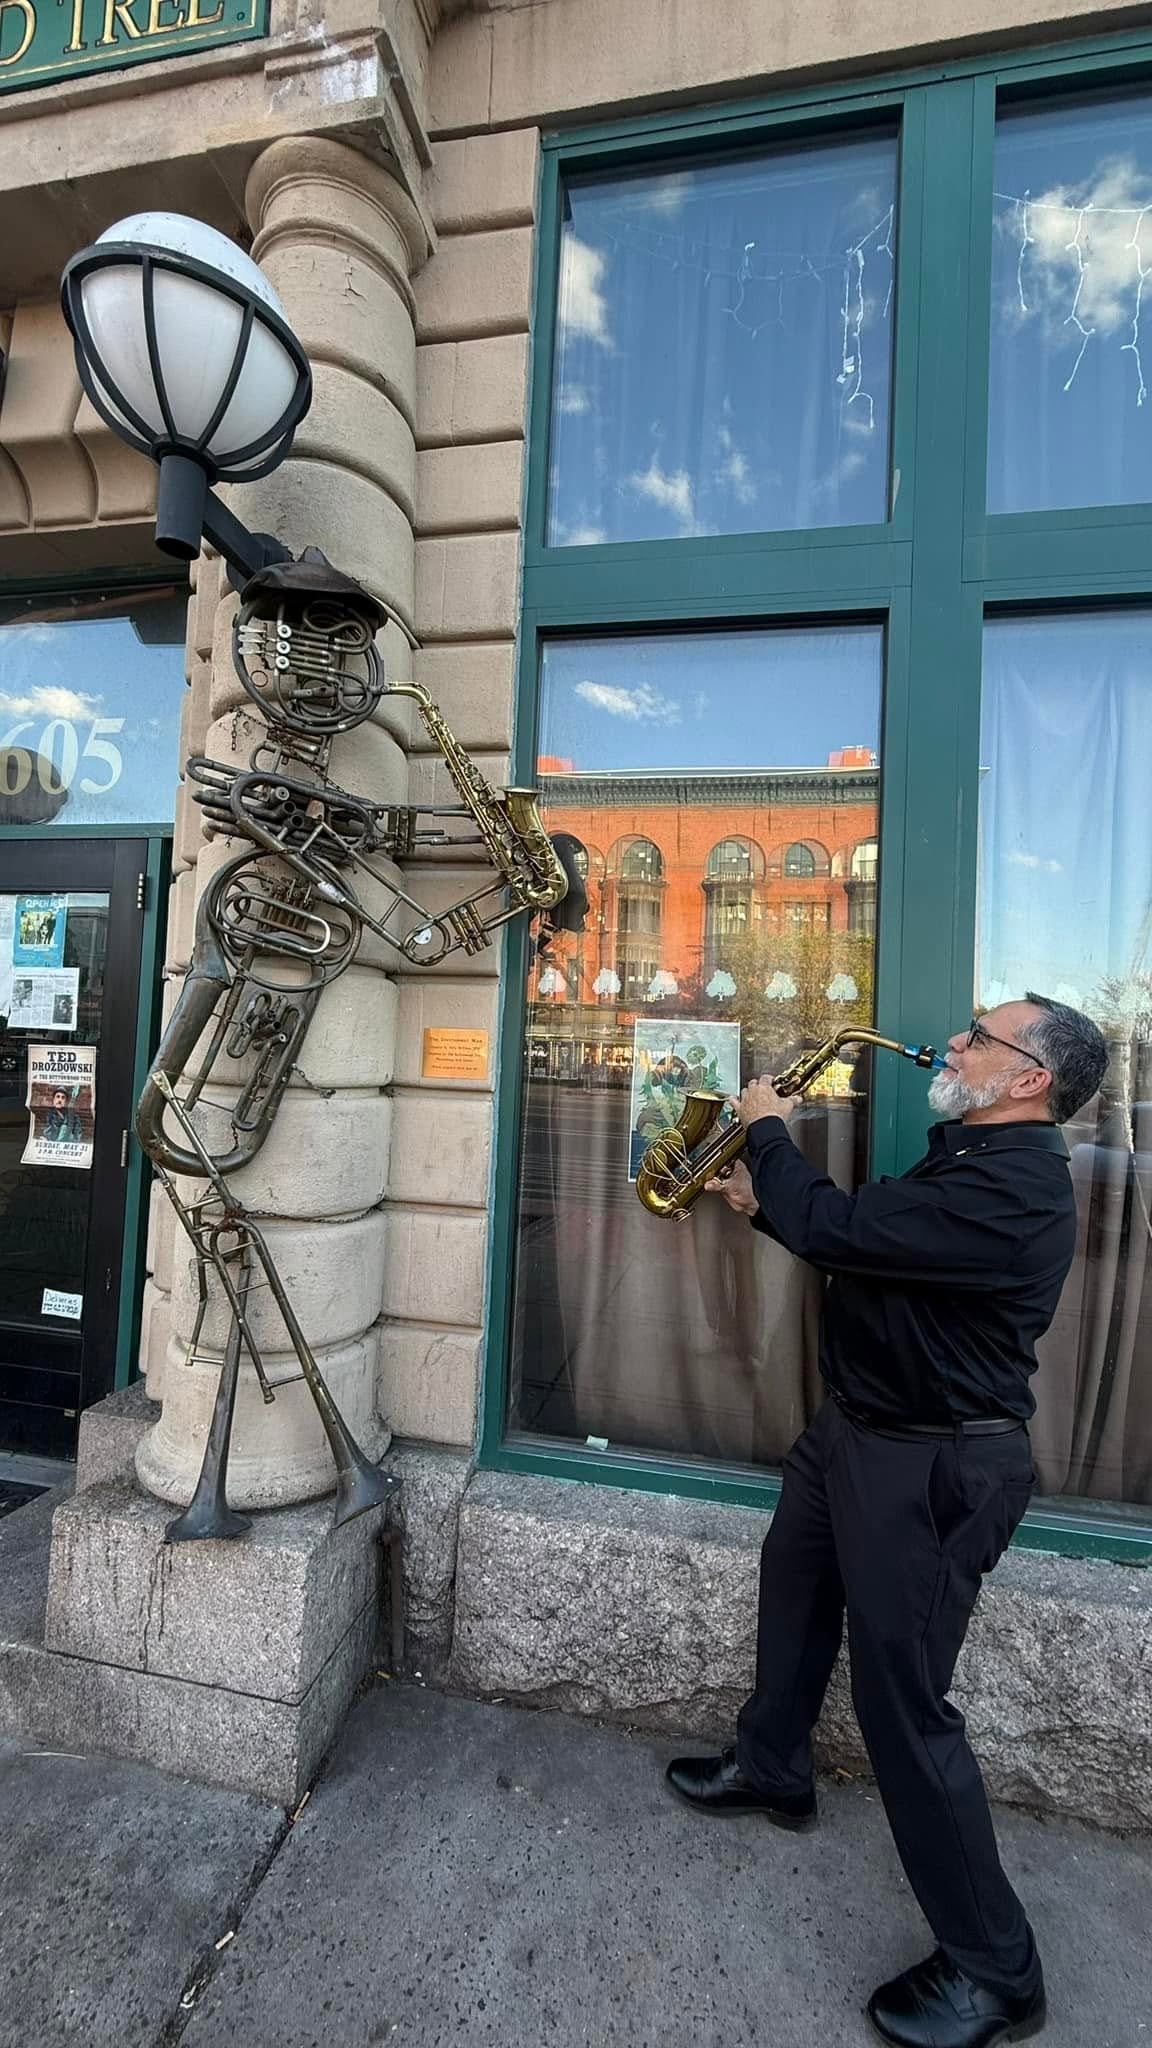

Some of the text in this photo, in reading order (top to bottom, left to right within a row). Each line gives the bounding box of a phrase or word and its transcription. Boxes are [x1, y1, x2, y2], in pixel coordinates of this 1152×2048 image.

[0, 718, 126, 796] 605
[47, 1051, 77, 1062] TED
[31, 1061, 93, 1073] DROZDOWSKI
